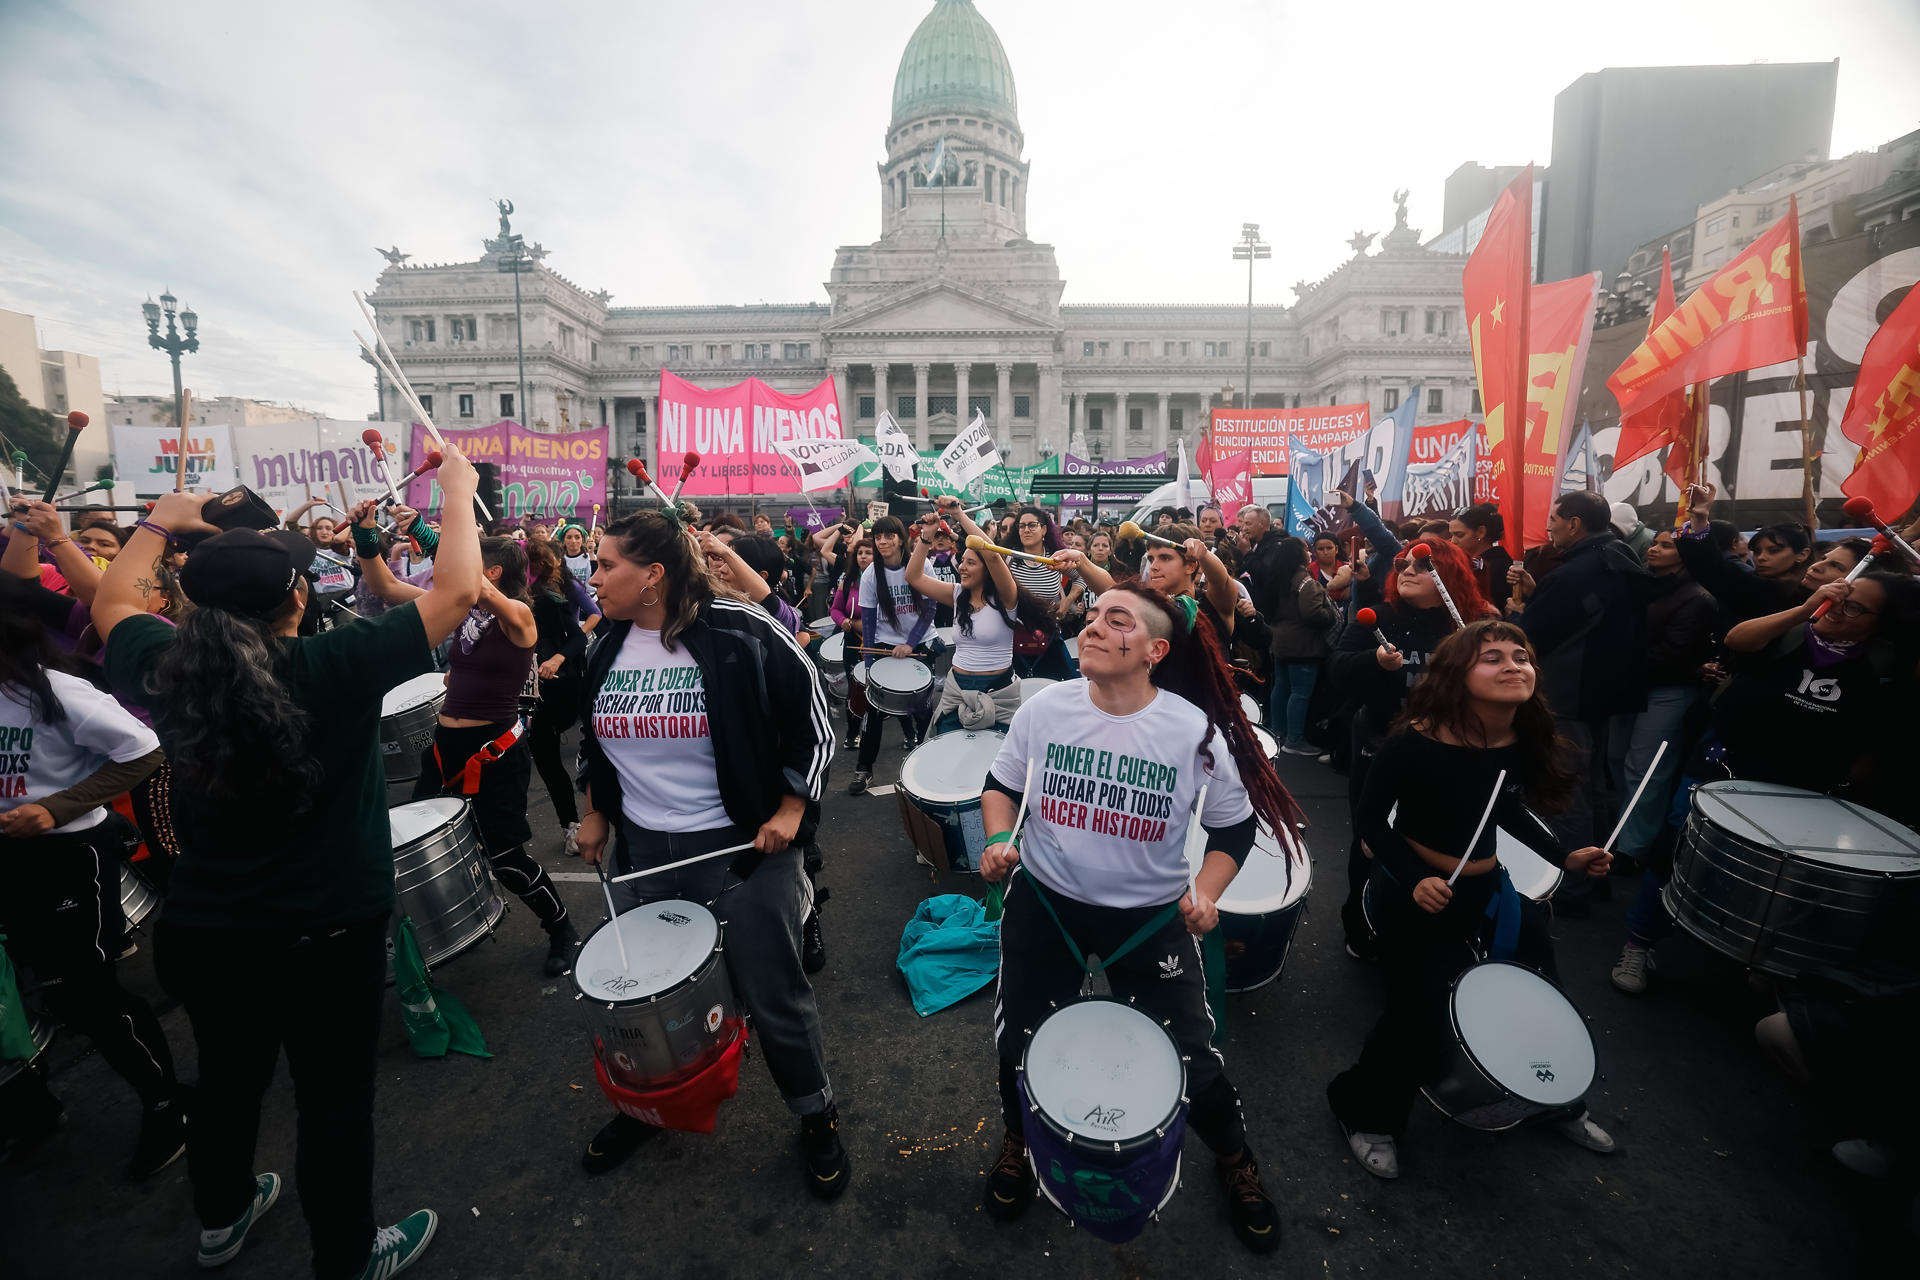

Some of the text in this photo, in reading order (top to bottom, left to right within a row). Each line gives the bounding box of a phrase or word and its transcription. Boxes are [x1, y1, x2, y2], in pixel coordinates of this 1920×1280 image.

[661, 399, 841, 456] NI UNA MENOS
[1215, 411, 1365, 433] DESTITUCIÓN DE JUECES Y
[461, 436, 505, 457] UNA
[510, 435, 602, 460] MENOS
[1215, 435, 1285, 447] FUNCIONARIOS
[519, 464, 573, 478] queremos
[701, 465, 708, 477] Y
[711, 464, 749, 477] LIBRES
[752, 464, 776, 477] NOS
[640, 668, 656, 693] EL
[637, 694, 663, 714] POR
[667, 691, 706, 714] TODXS
[0, 725, 33, 752] RPO
[592, 715, 710, 739] HACER HISTORIA
[0, 753, 31, 775] DXS
[1044, 741, 1178, 794] PONER EL CUERPO
[1042, 771, 1173, 820] LUCHAR POR TODXS
[1040, 796, 1167, 843] HACER HISTORIA
[1159, 967, 1184, 980] adidas
